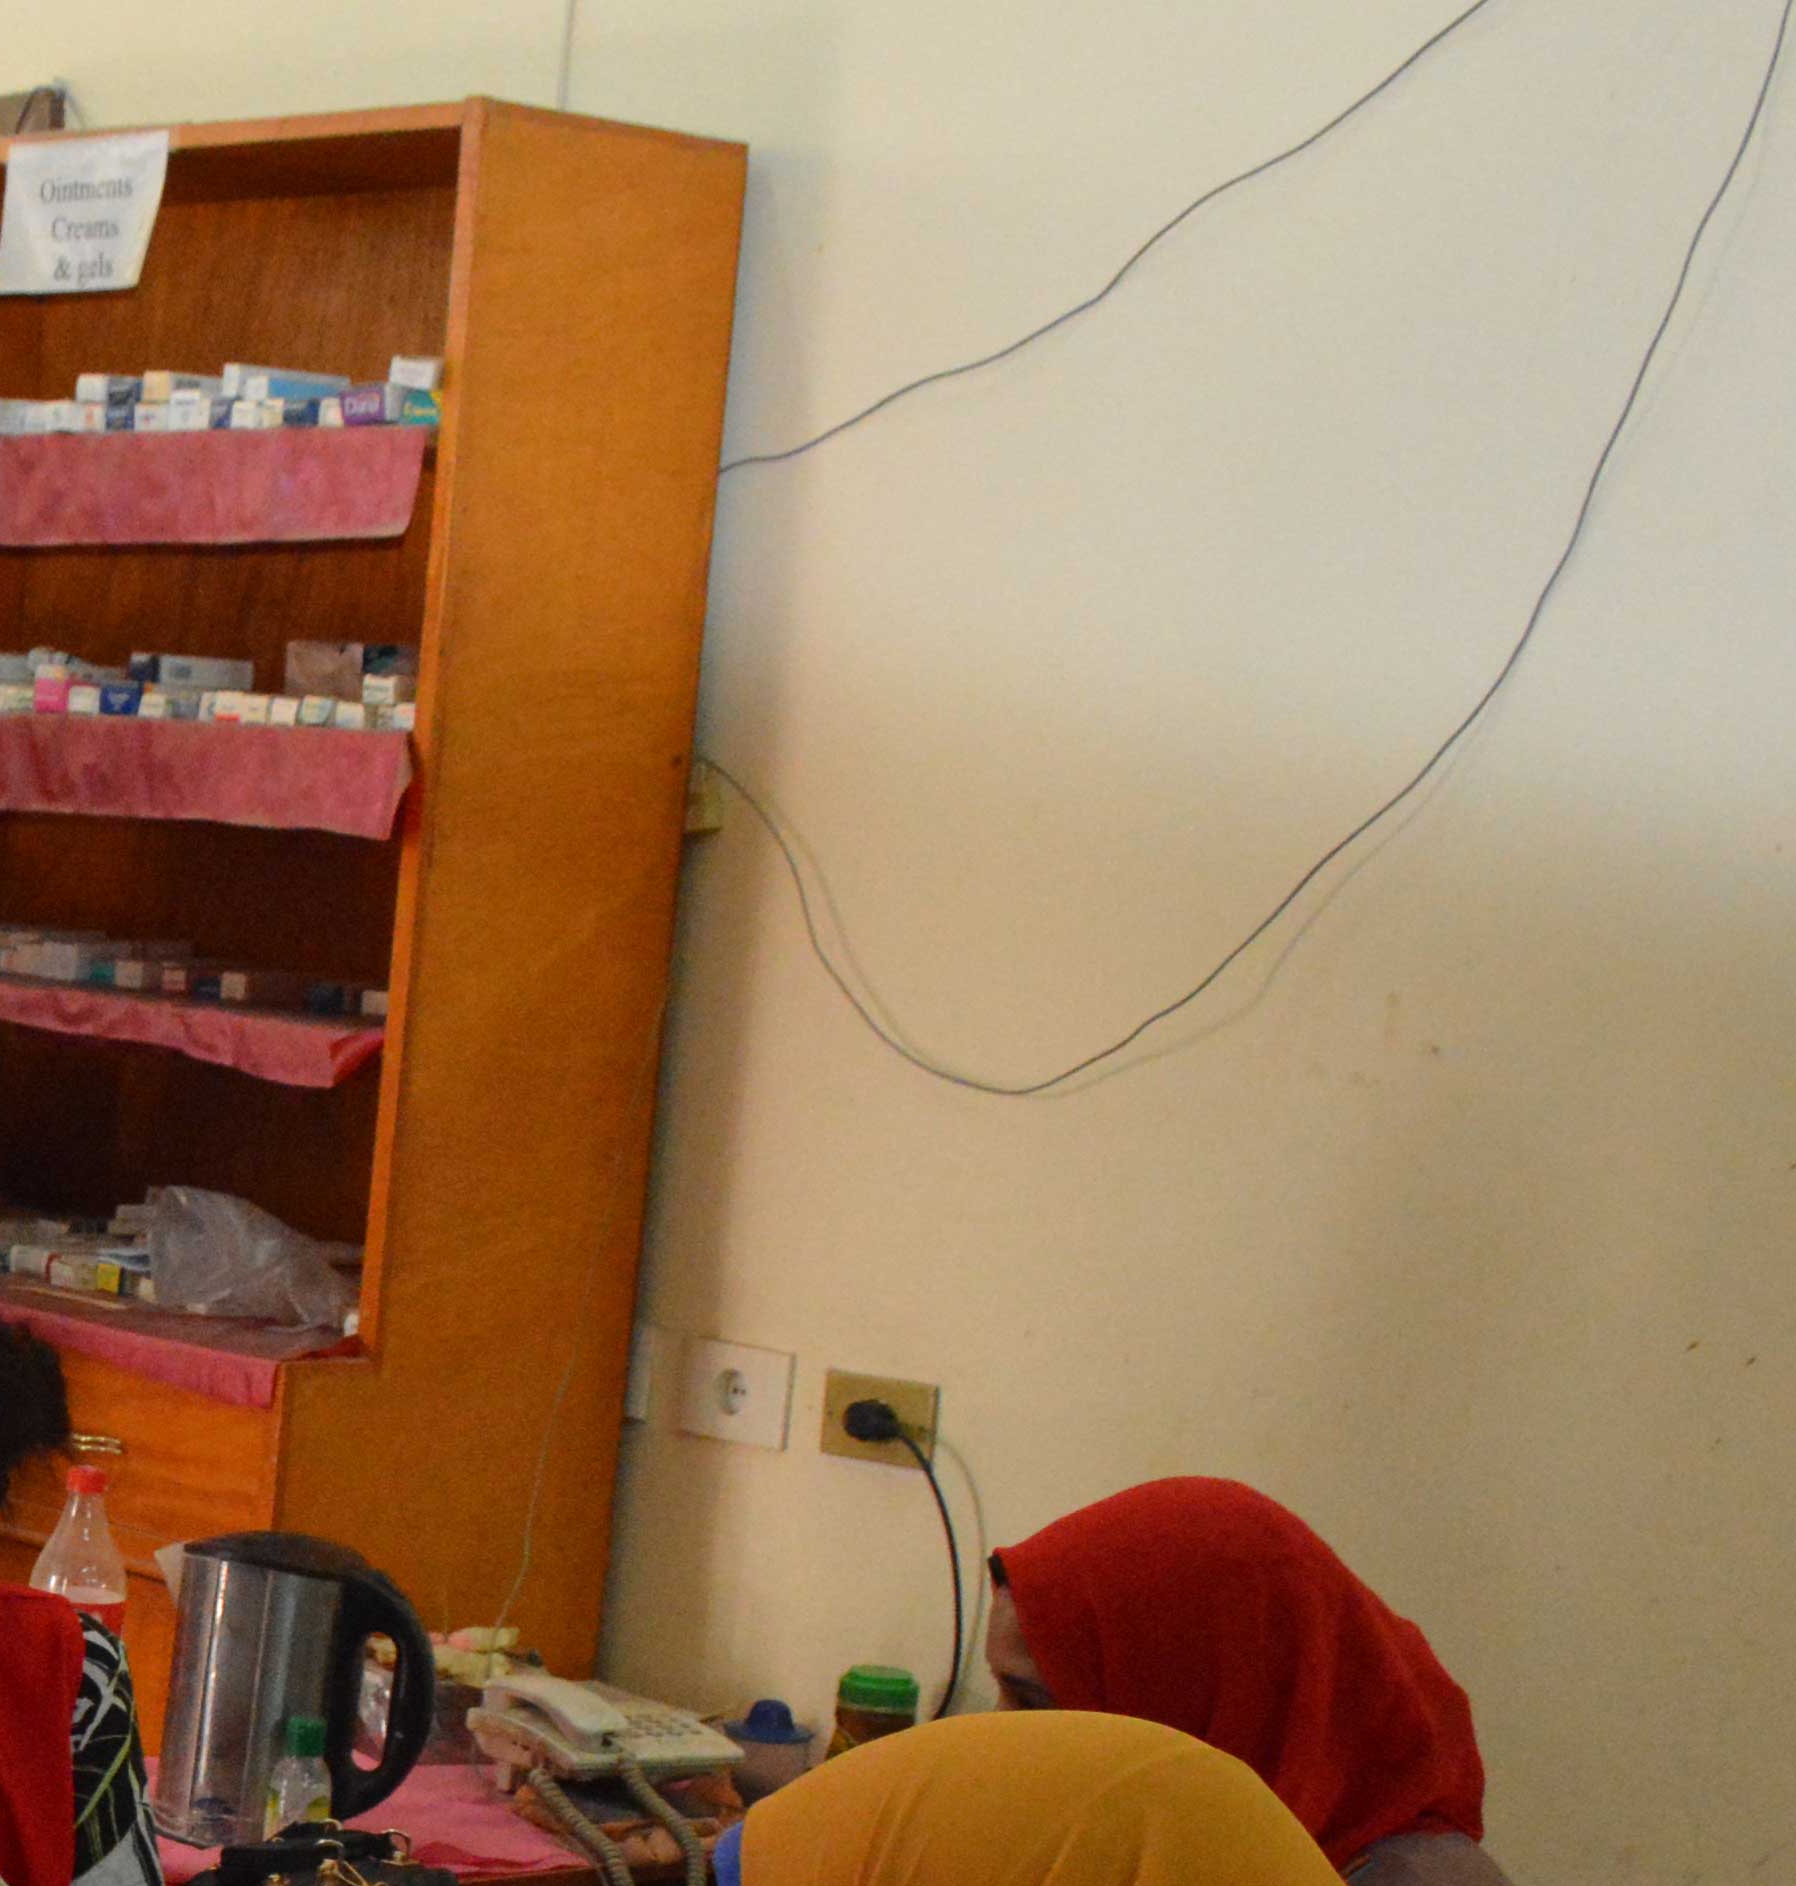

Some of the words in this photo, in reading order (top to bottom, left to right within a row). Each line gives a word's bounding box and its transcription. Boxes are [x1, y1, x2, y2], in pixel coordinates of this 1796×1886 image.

[40, 177, 134, 204] Ointments
[51, 215, 119, 243] Creams
[54, 255, 71, 281] &
[78, 253, 114, 287] gels
